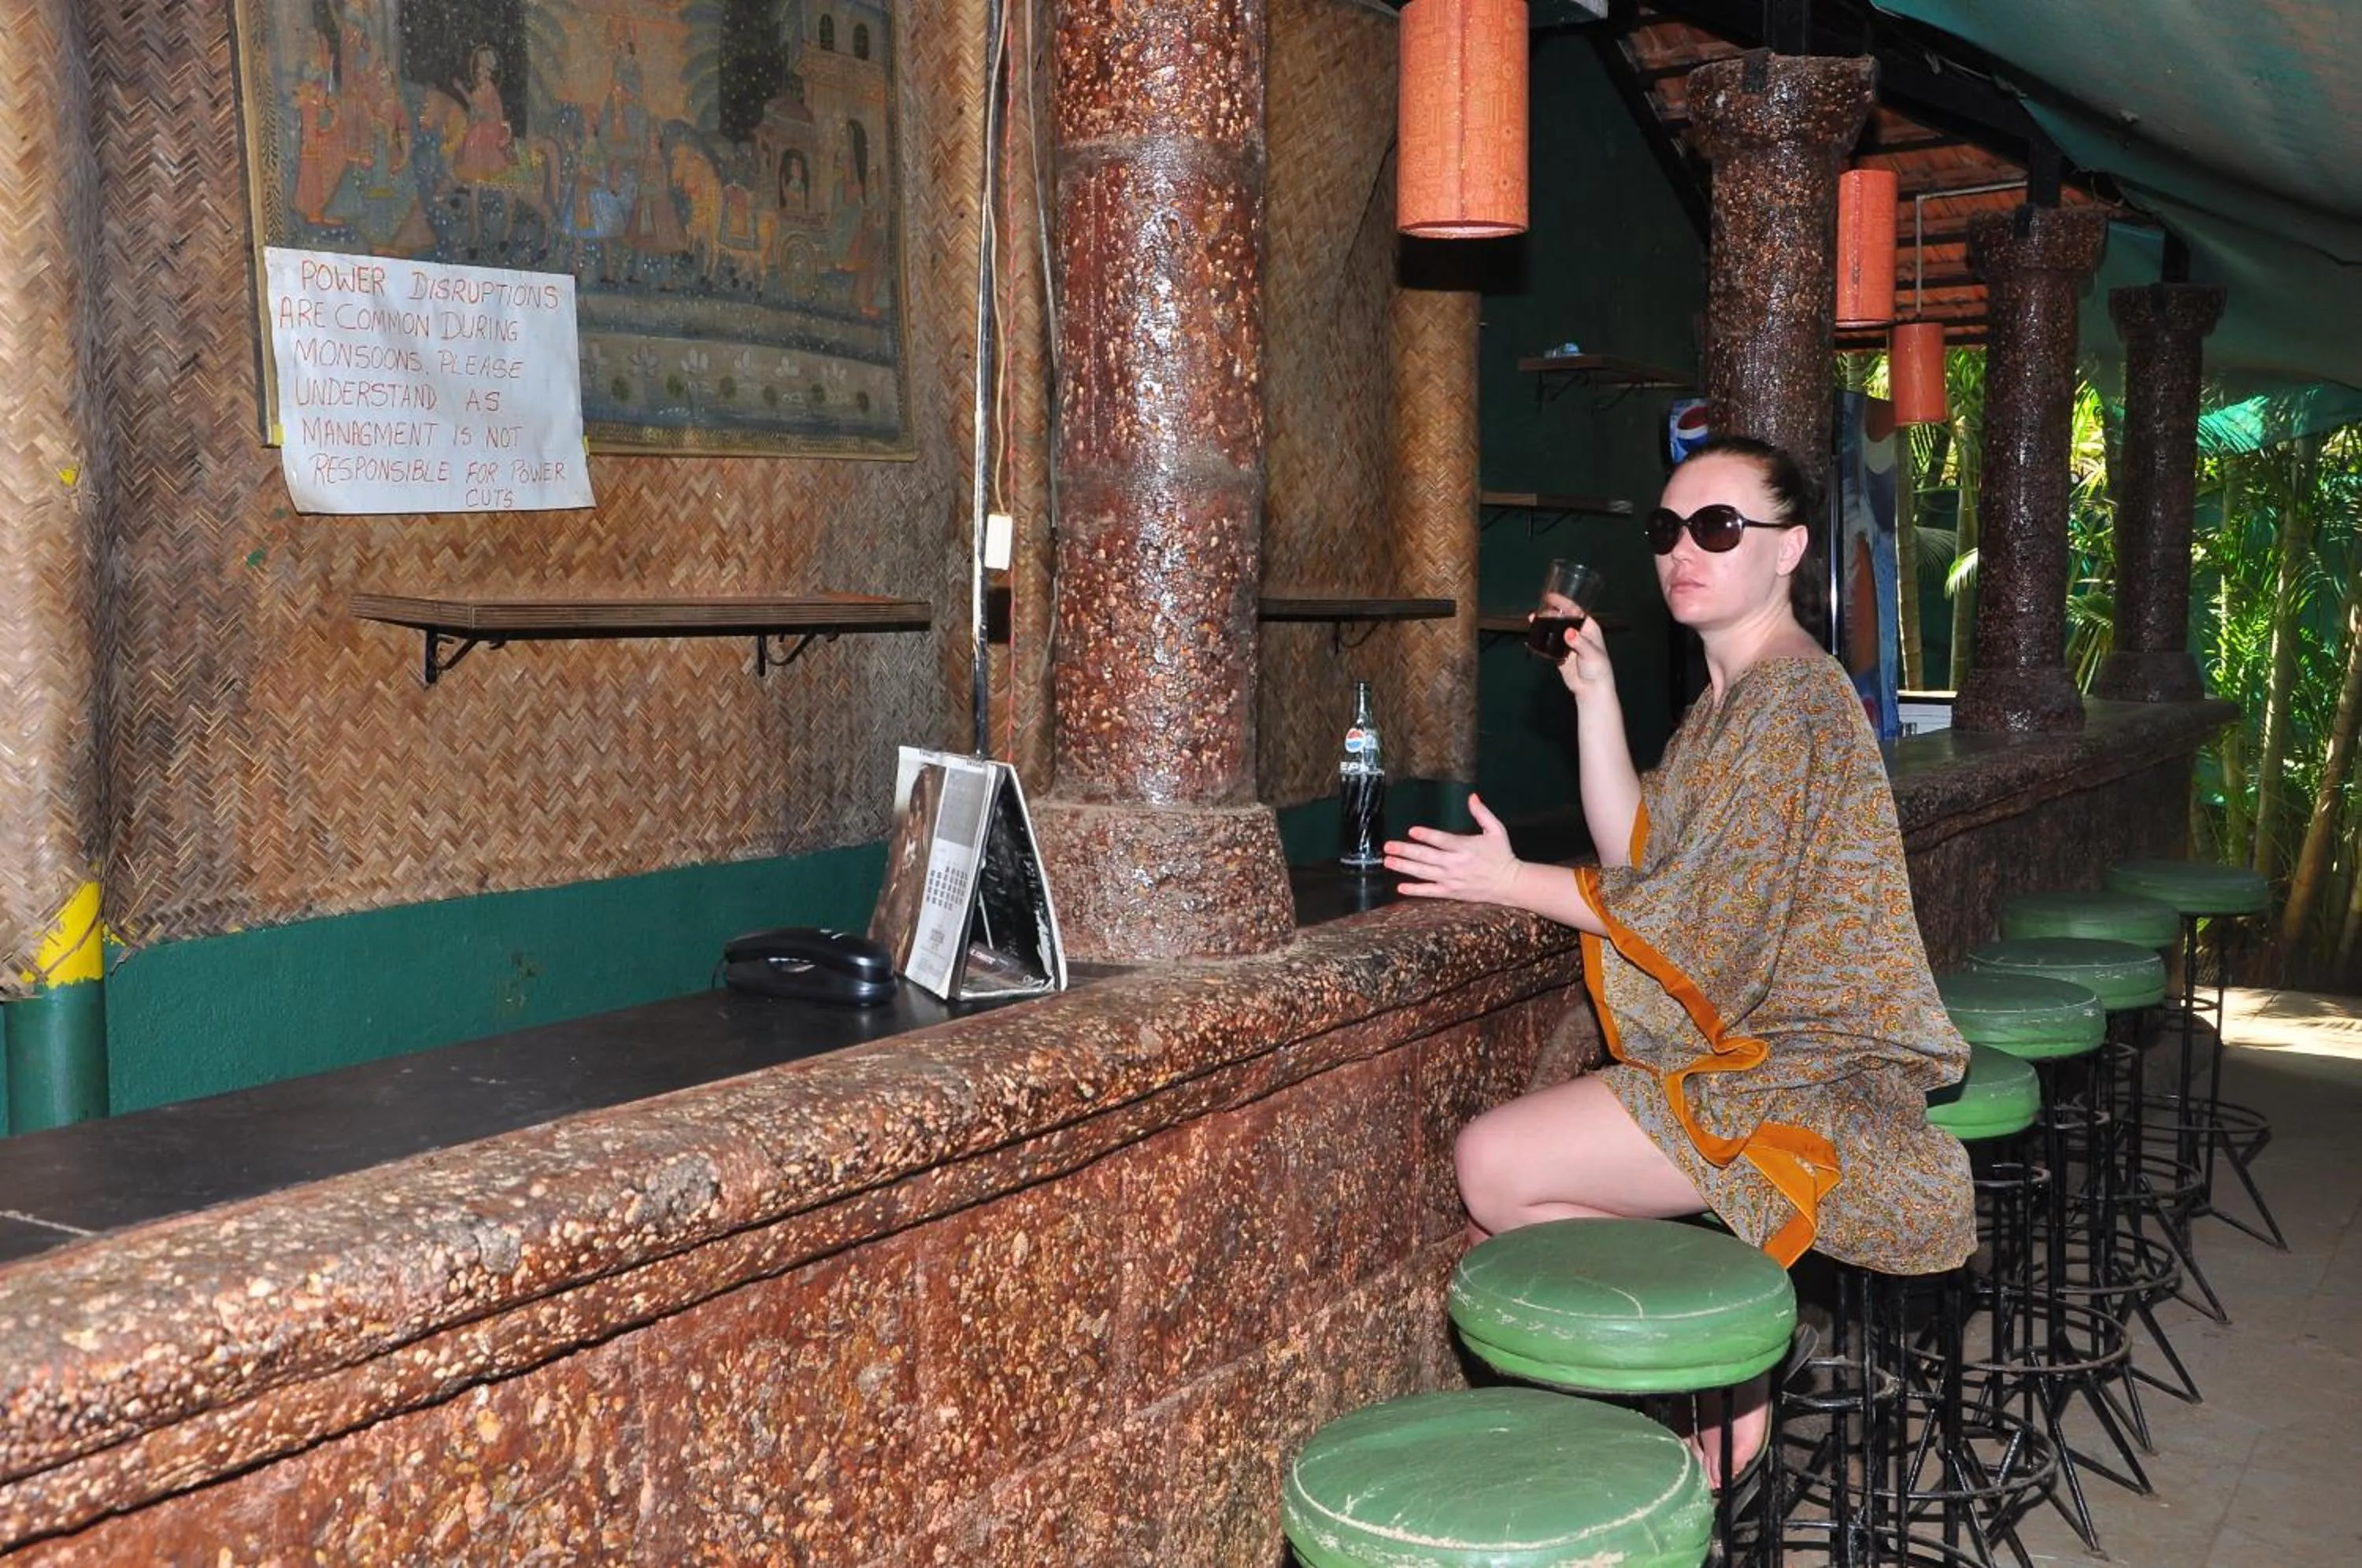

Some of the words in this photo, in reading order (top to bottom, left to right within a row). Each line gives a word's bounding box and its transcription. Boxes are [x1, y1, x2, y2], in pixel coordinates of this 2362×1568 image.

[302, 257, 385, 296] POWER
[407, 272, 559, 309] DISRUPTIONS
[280, 295, 326, 329] ARE
[335, 303, 429, 338] COMMON
[440, 311, 518, 342] DURING
[438, 349, 524, 379] PLEASE
[295, 377, 437, 410] UNDERSTAND
[465, 389, 500, 412] AS
[302, 416, 439, 448] MANAGMENT
[454, 424, 472, 446] IS
[486, 425, 523, 449] NOT
[309, 453, 450, 486] RESPONSIBLE
[465, 461, 498, 484] FOR
[511, 459, 566, 483] POWER
[465, 488, 516, 508] CUTS
